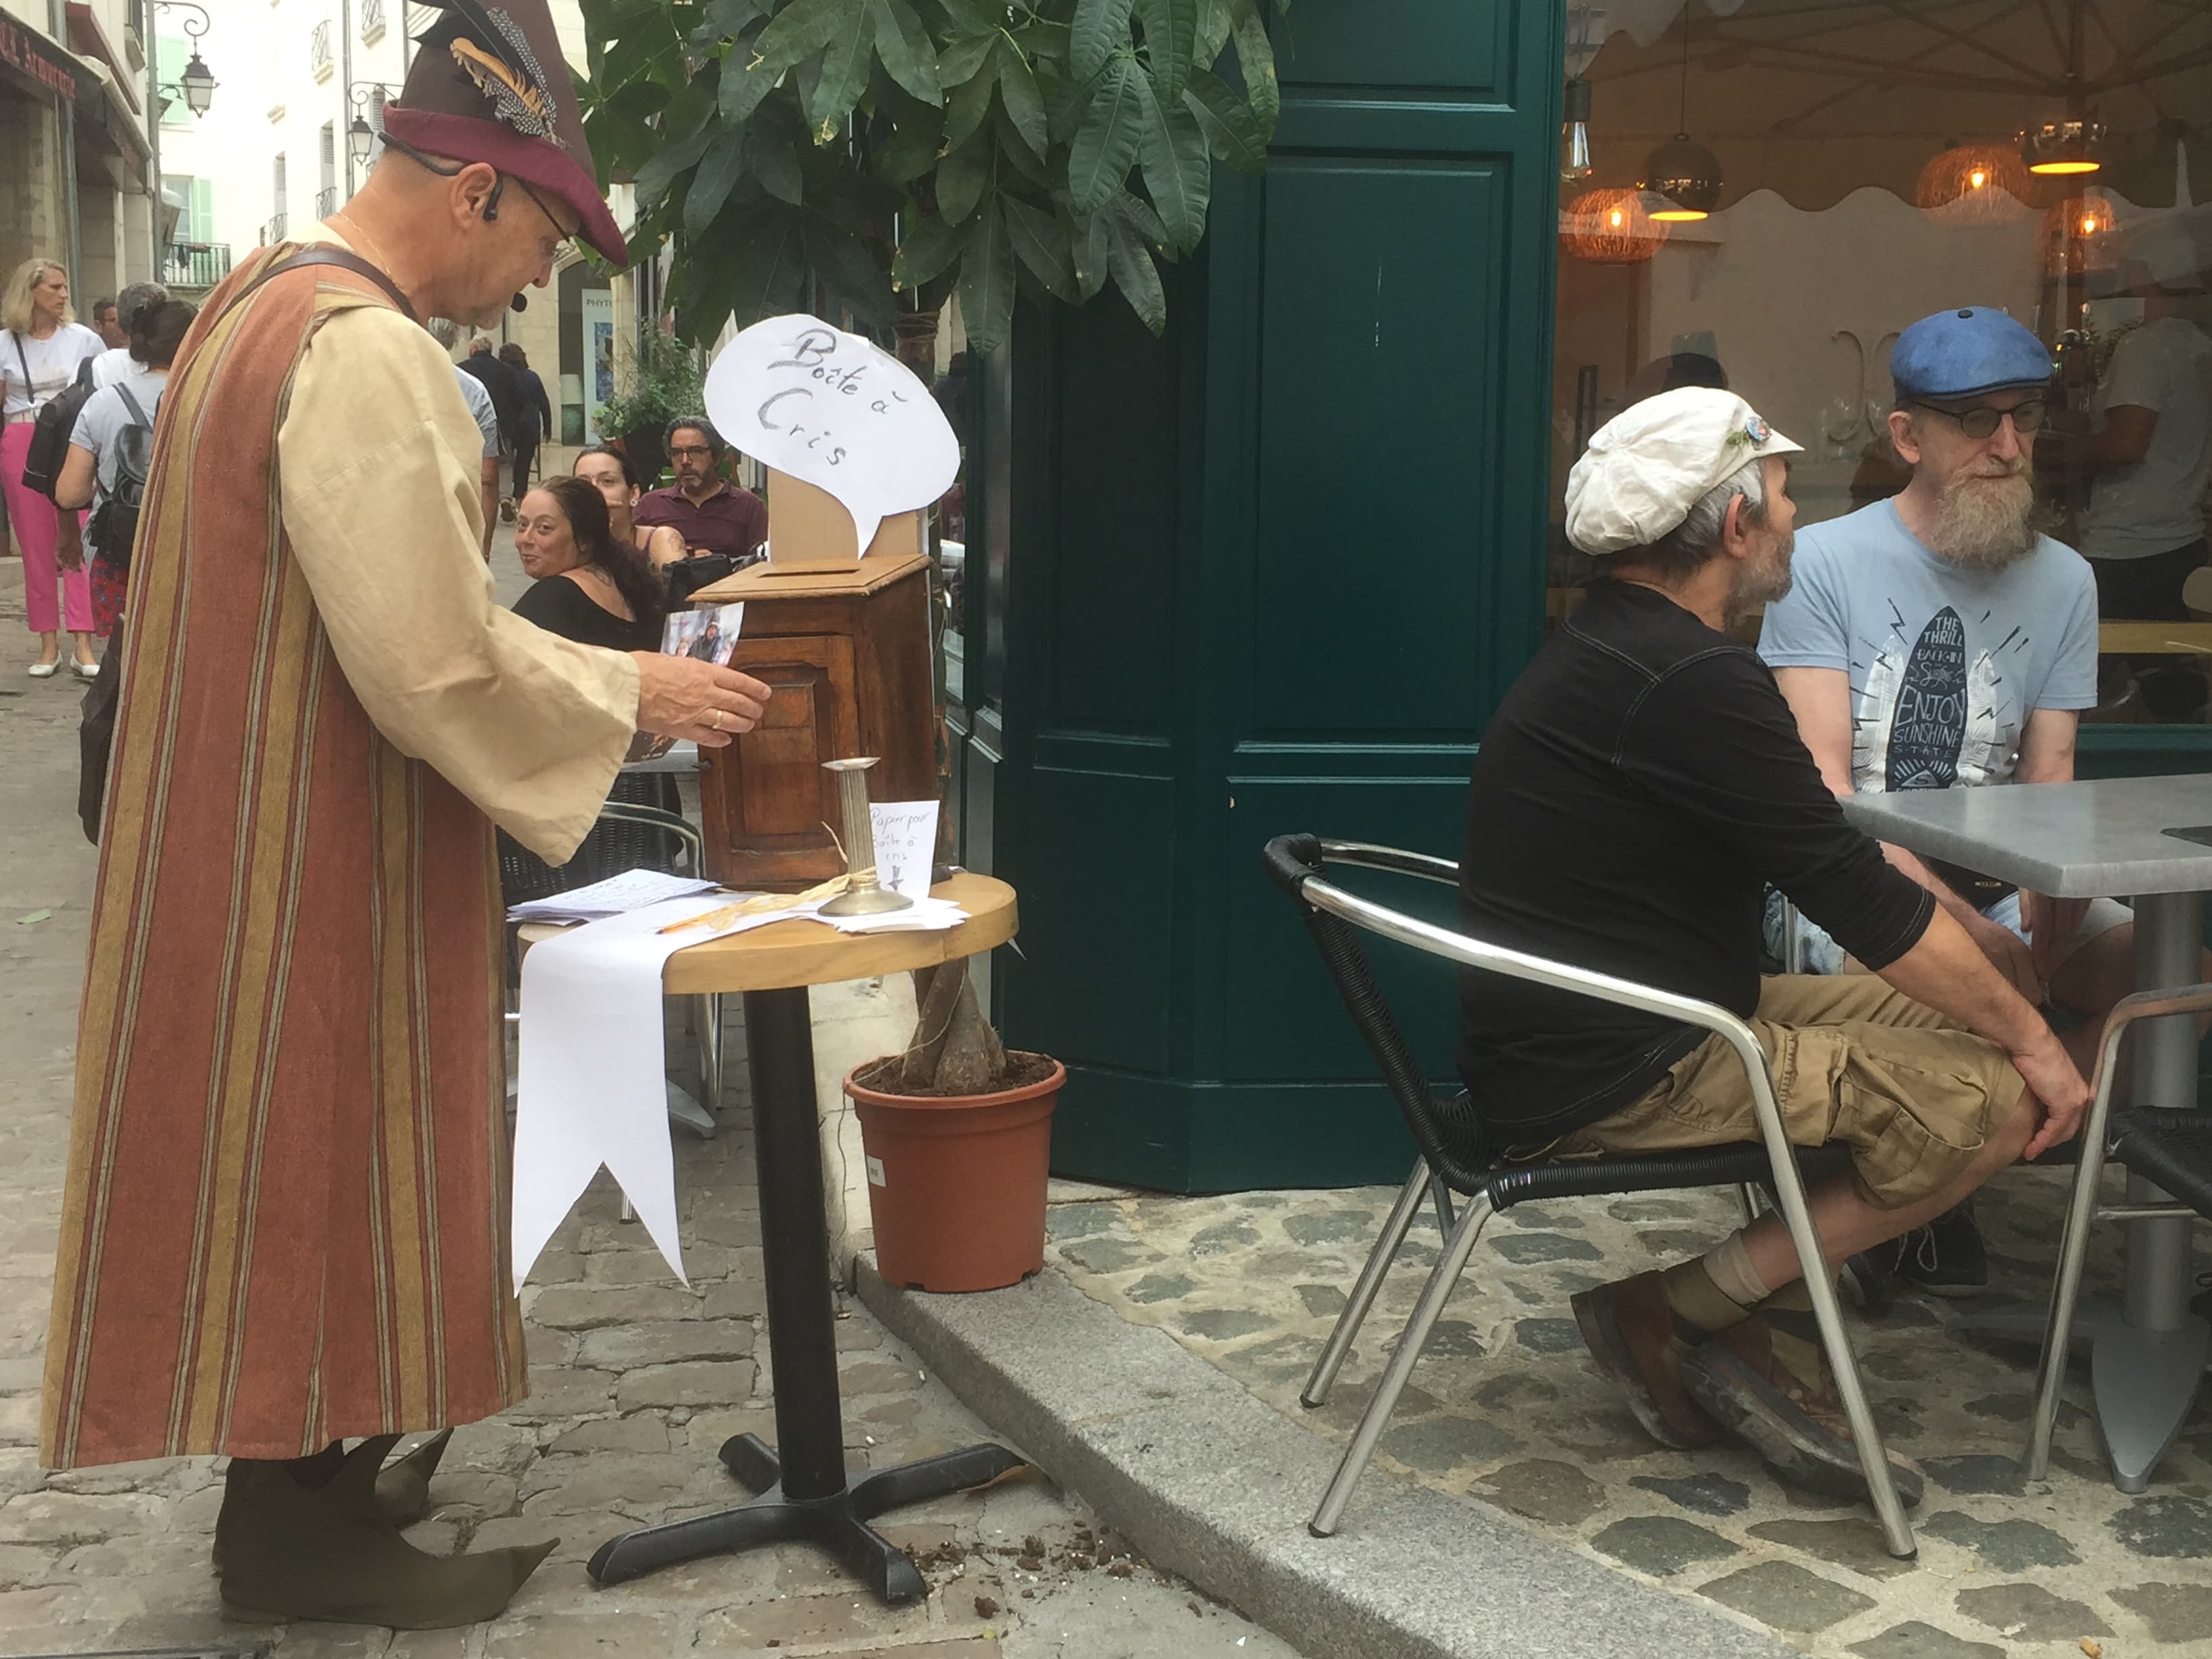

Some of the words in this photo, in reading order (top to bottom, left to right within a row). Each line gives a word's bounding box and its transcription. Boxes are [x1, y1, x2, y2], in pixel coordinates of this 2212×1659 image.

[766, 328, 868, 395] Boîte
[871, 390, 908, 415] à
[757, 387, 846, 466] Cris
[1924, 630, 1963, 647] THRILL
[1936, 617, 1960, 632] THE
[1895, 684, 1966, 729] ENJOY
[1893, 722, 1961, 747] SUNSHINE
